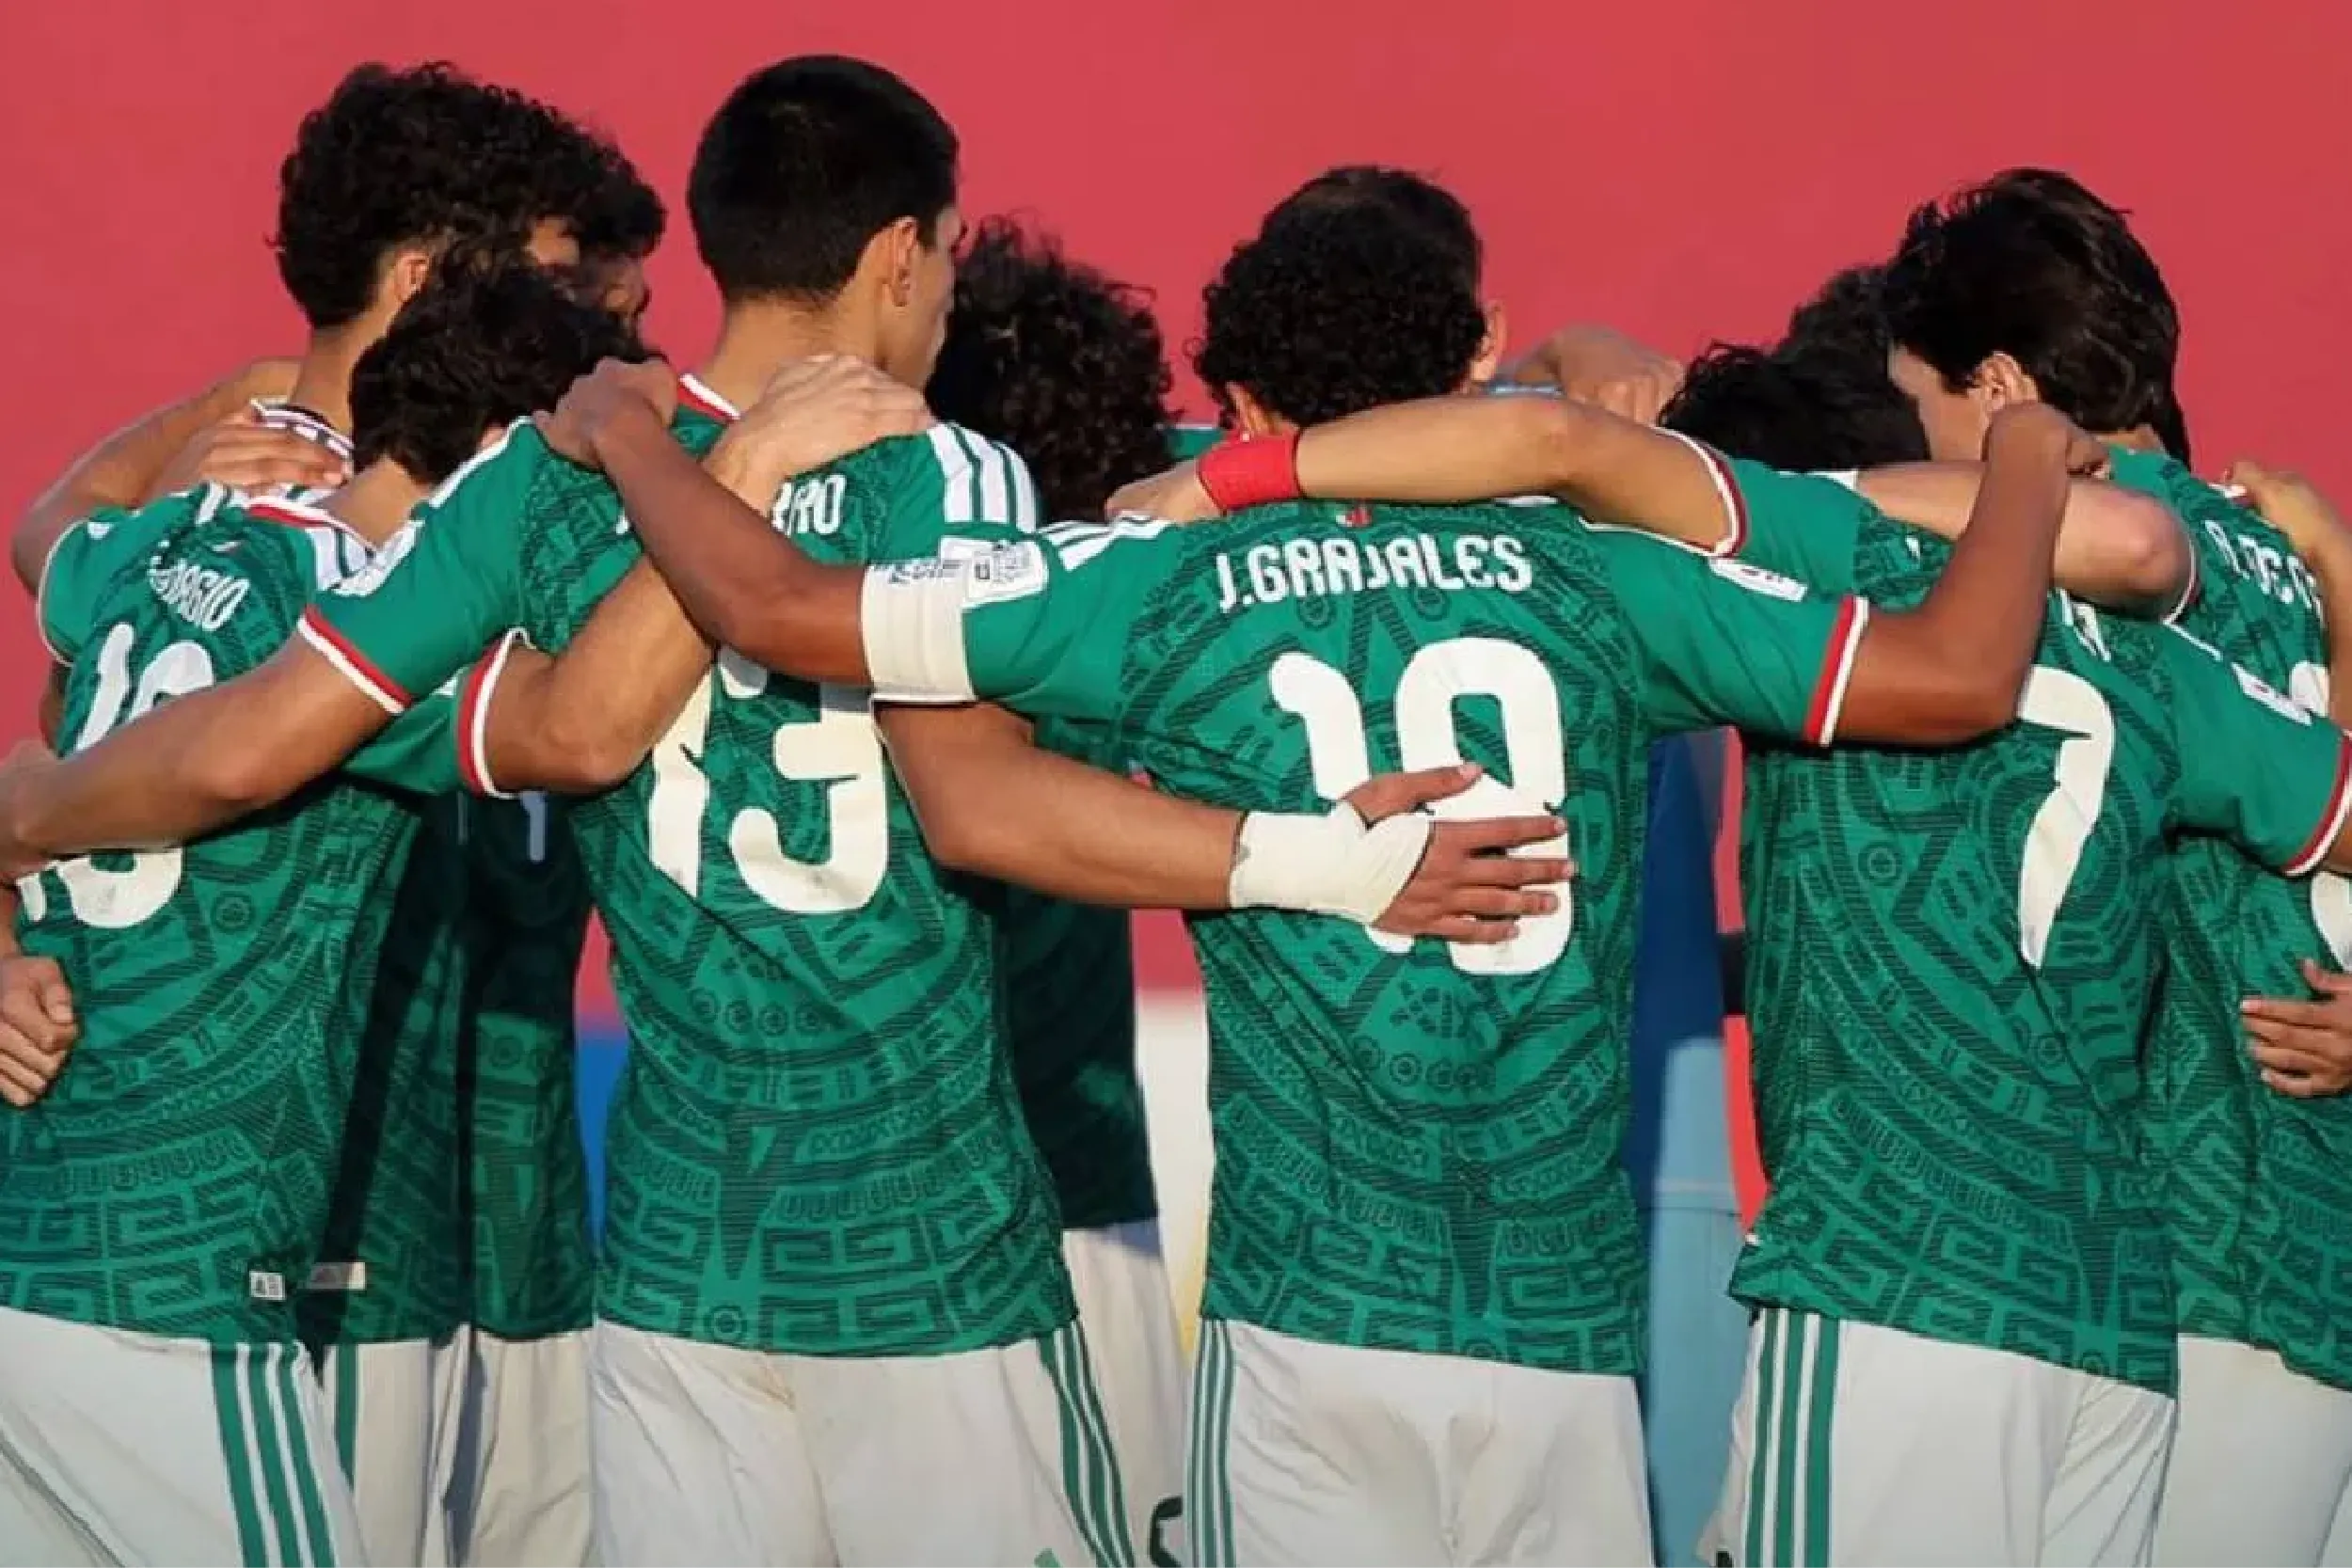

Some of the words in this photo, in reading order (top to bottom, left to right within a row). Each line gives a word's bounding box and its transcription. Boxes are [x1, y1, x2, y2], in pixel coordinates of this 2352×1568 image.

[1216, 532, 1533, 613] J.GRAJALES
[648, 645, 888, 914] 13
[2017, 664, 2116, 960] 7
